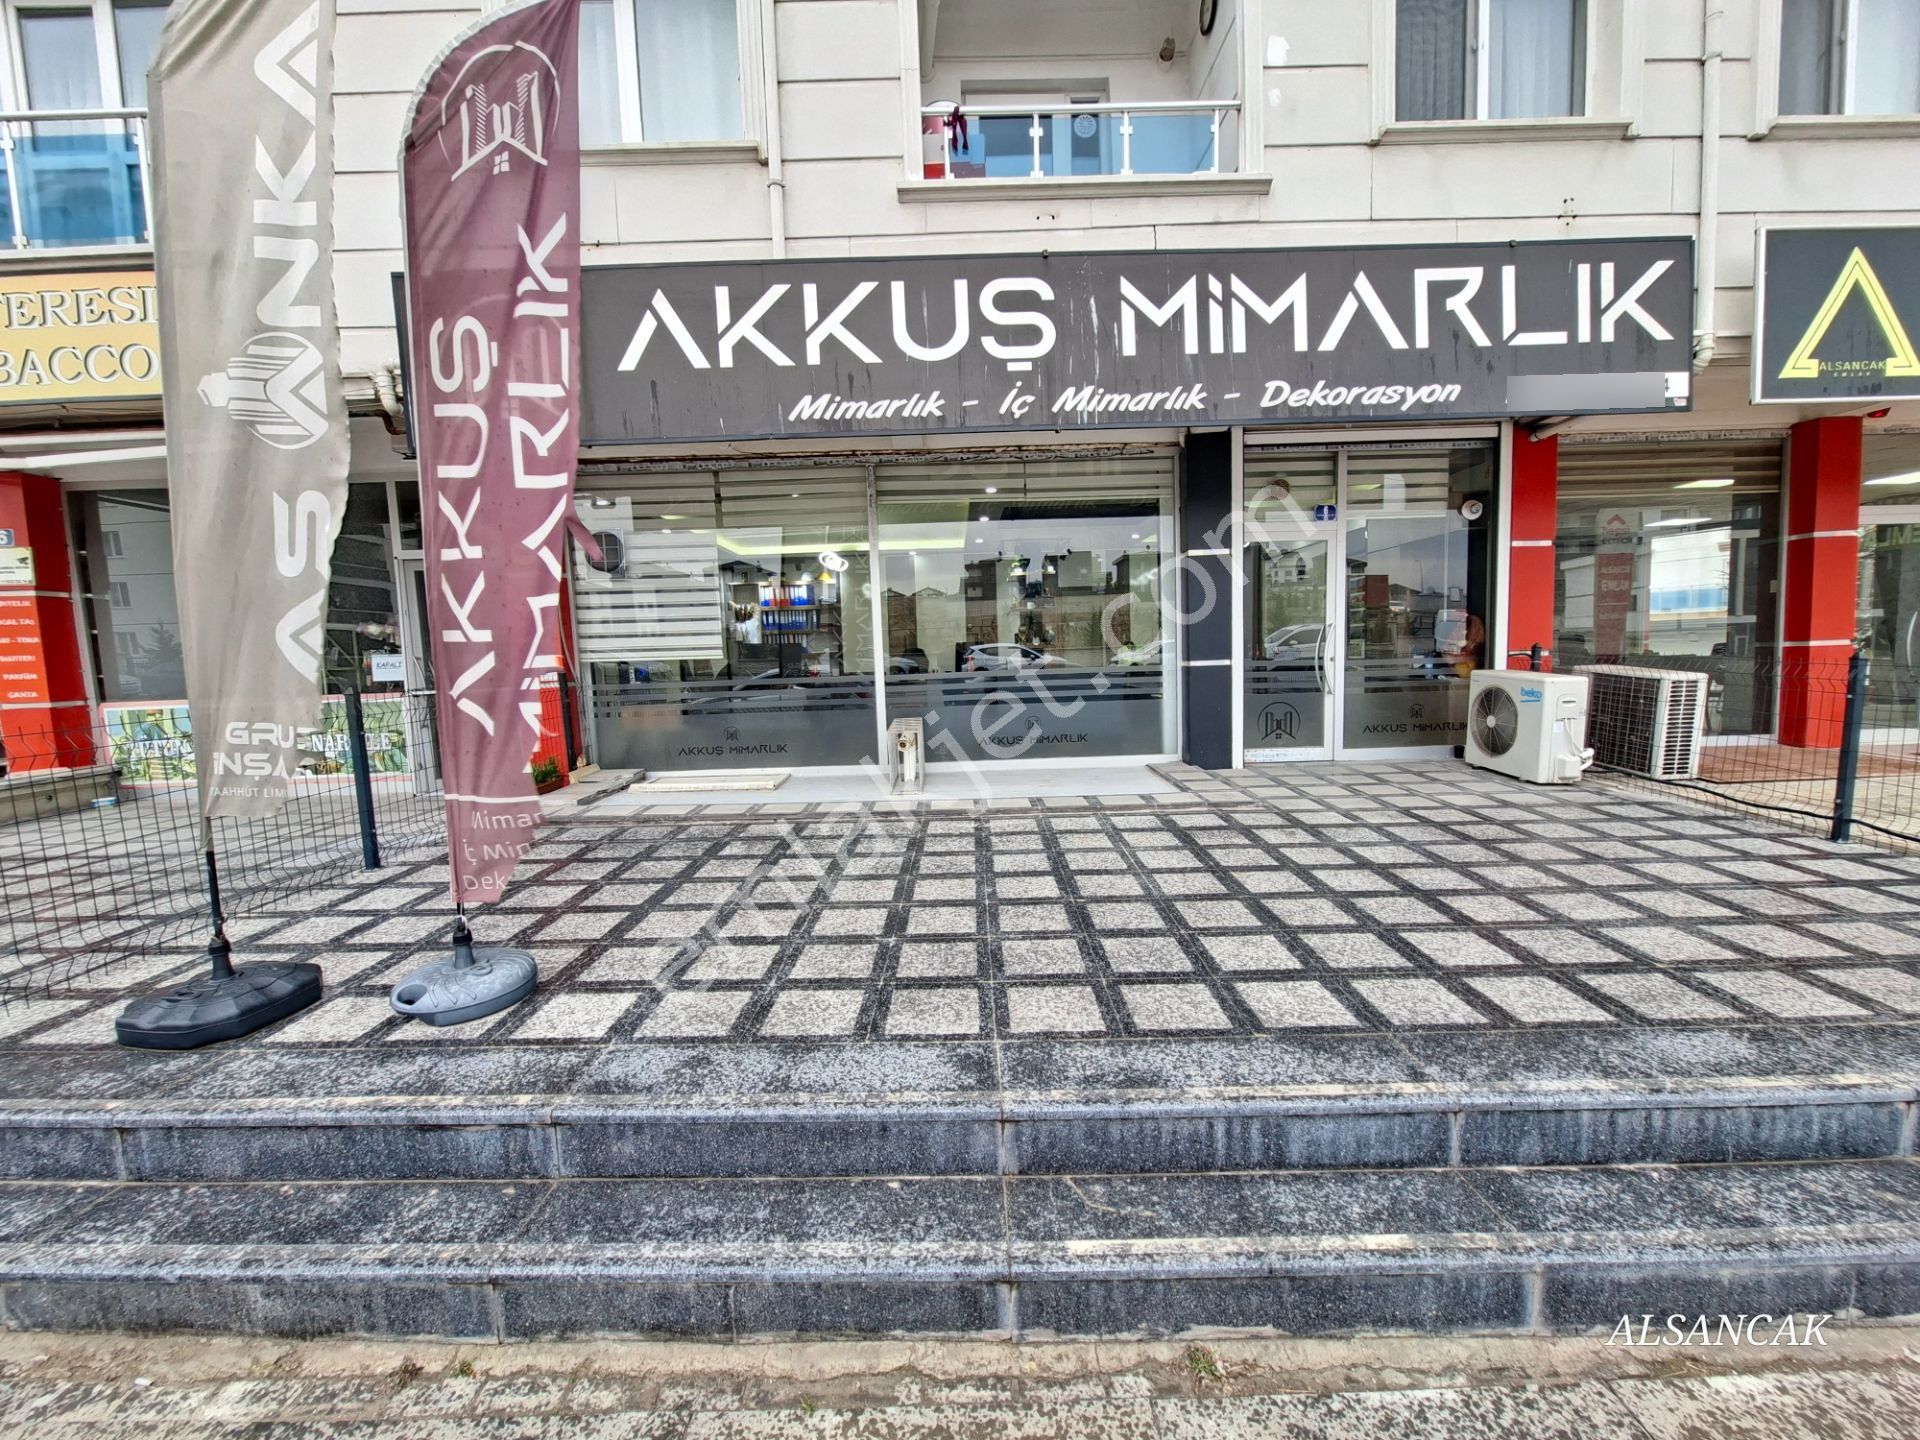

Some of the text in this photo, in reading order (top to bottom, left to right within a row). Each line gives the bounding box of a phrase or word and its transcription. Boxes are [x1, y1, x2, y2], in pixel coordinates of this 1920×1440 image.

[0, 286, 158, 329] ERESI
[617, 260, 1675, 371] AKKUŞ MİMARLIK
[1819, 360, 1886, 371] ALSANCAK
[788, 390, 945, 422] Mimarlık
[999, 381, 1035, 418] İç
[1052, 383, 1208, 413] Mimarlık
[1260, 380, 1462, 411] Dekorasyon
[430, 315, 498, 737] AKKUŞ
[1520, 686, 1543, 699] beko
